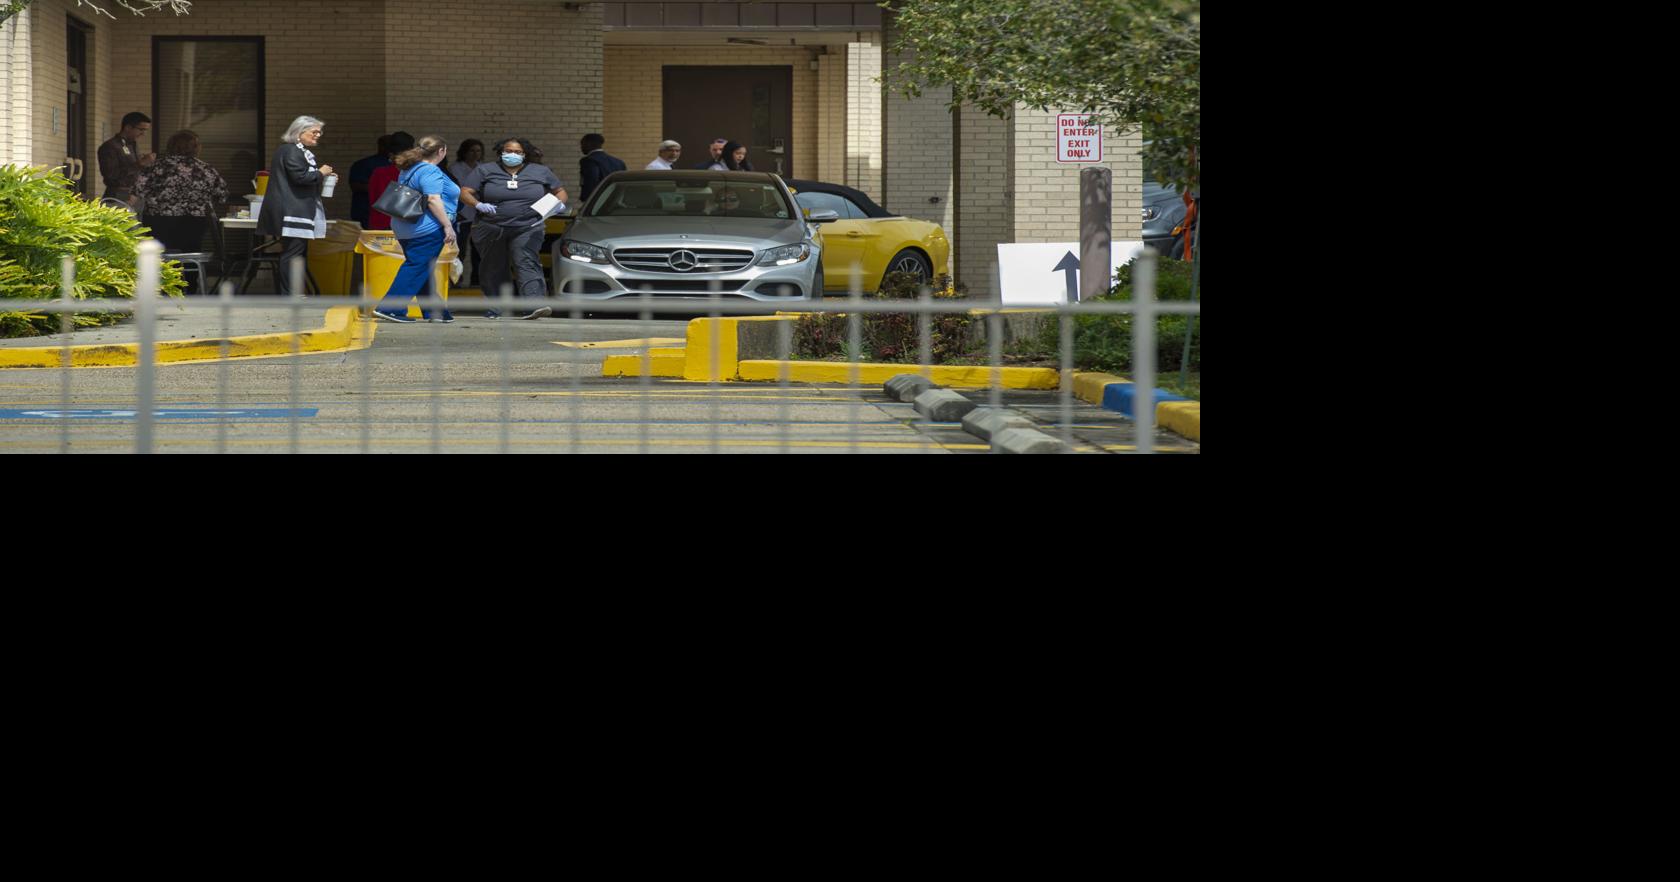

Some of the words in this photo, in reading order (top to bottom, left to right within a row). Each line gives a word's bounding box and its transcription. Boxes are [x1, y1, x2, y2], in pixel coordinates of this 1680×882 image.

[1063, 128, 1095, 136] ENTER
[1068, 140, 1090, 148] EXIT
[1067, 149, 1091, 157] ONLY
